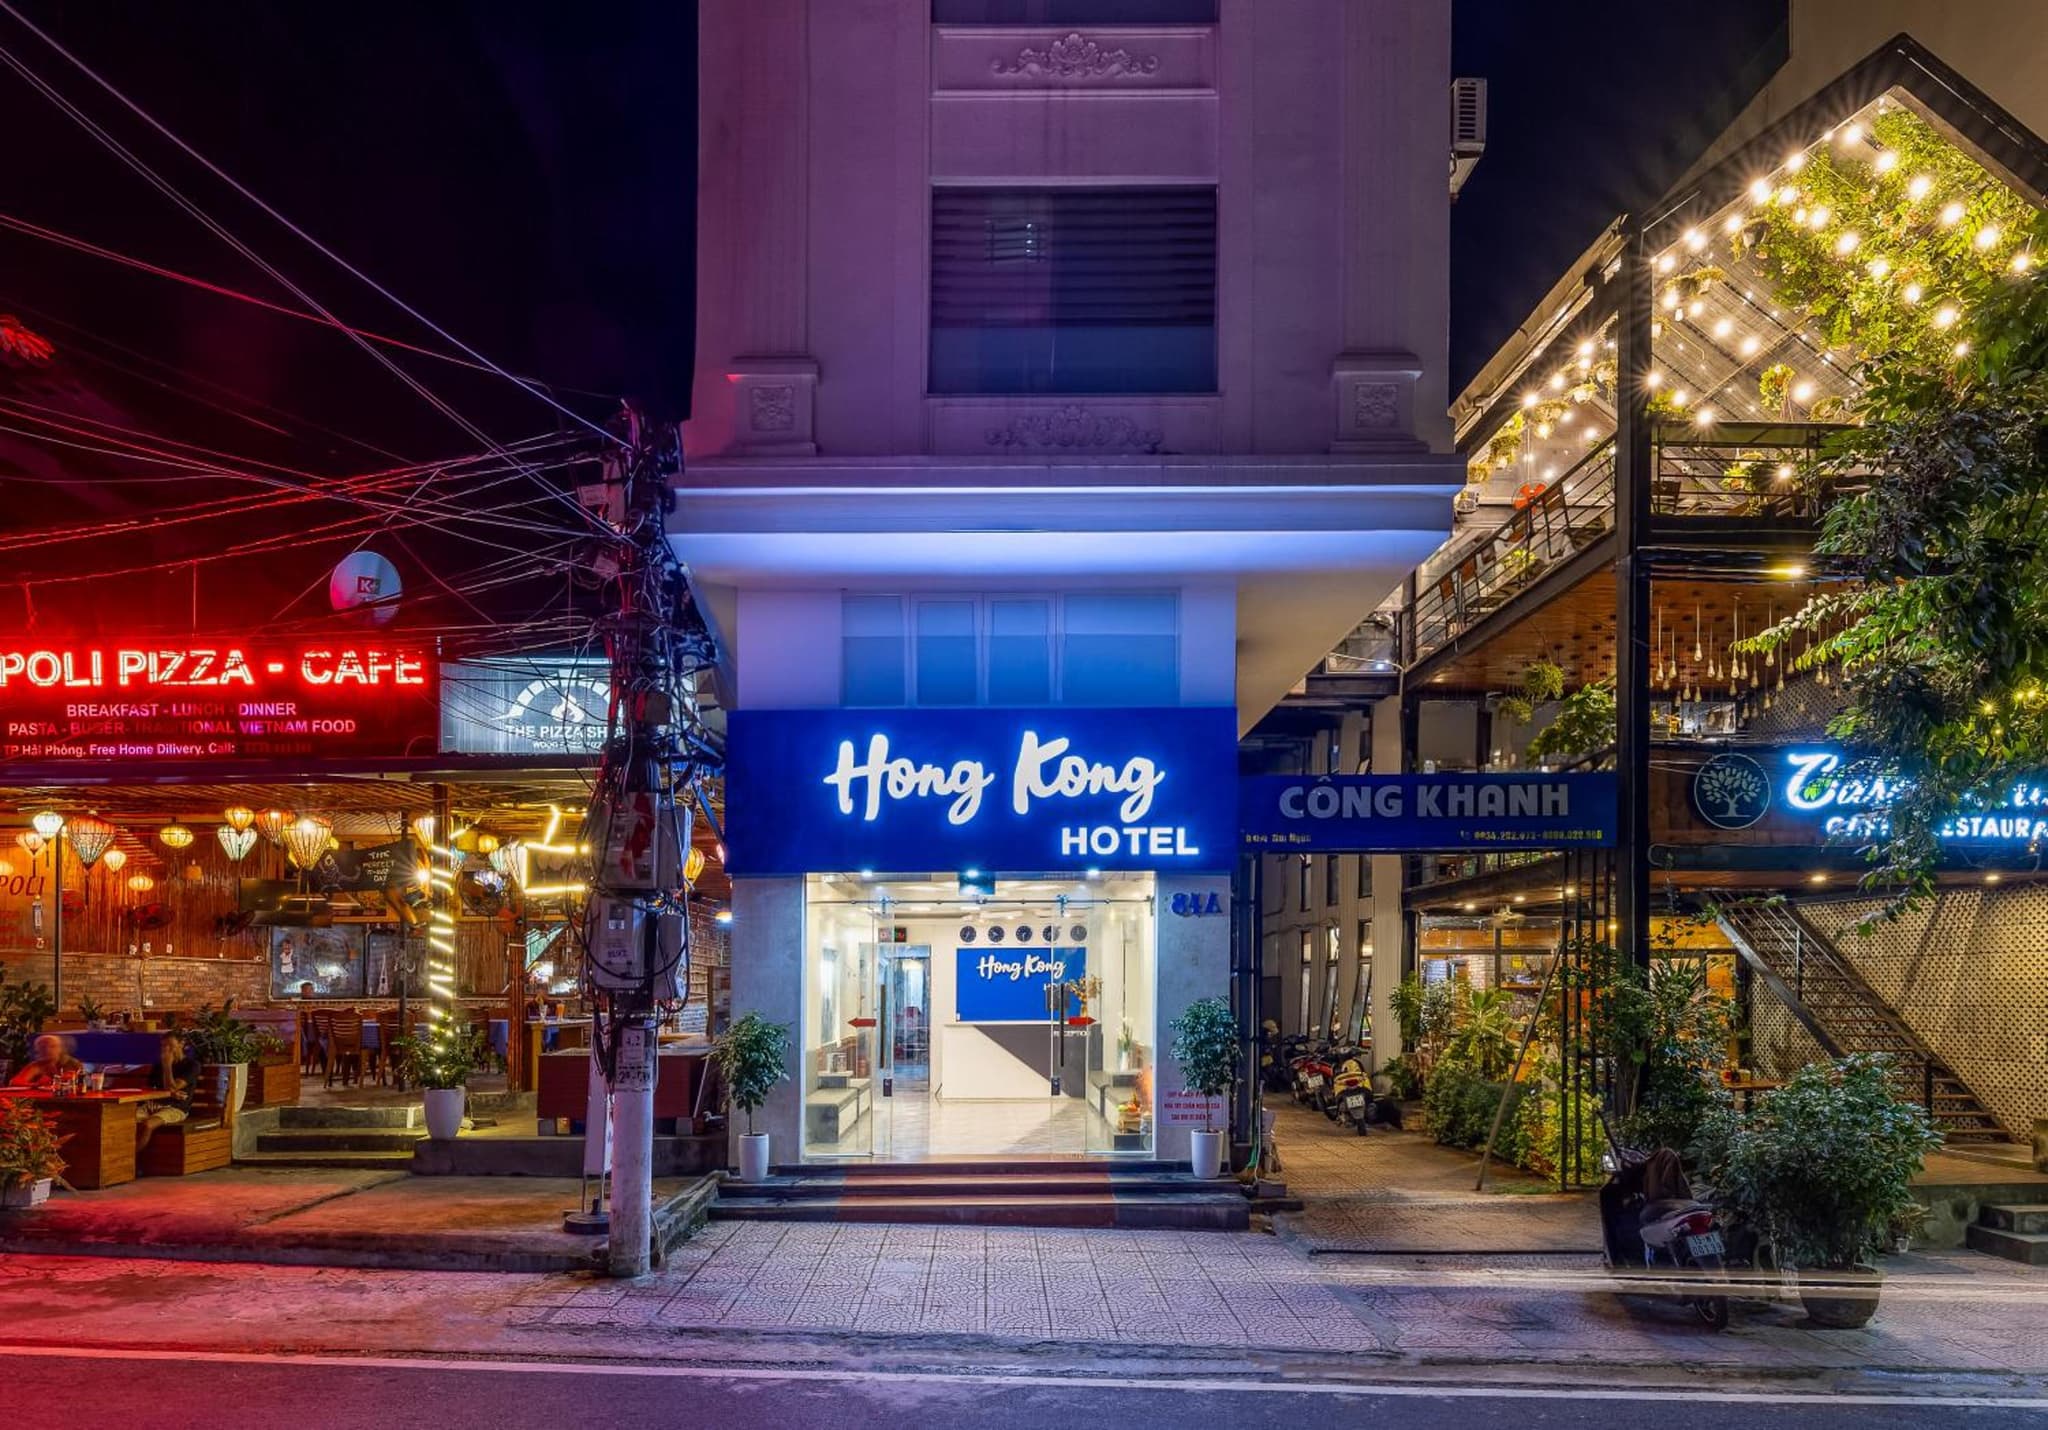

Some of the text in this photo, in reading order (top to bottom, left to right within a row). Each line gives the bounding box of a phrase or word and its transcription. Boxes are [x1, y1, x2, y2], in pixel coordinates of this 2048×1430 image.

[0, 652, 101, 687] POLI
[118, 650, 255, 686] PIZZA
[66, 703, 158, 718] BREAKFAST
[172, 703, 225, 717] LUNCH
[239, 702, 297, 717] DINNER
[8, 721, 57, 736] PASTA
[239, 719, 308, 734] VIETNAM
[312, 719, 356, 733] FOOD
[540, 725, 584, 738] PIZZA
[89, 742, 116, 755] Free
[119, 742, 153, 755] Home
[156, 741, 204, 756] Dilivery.
[208, 742, 236, 755] Call:
[823, 730, 1166, 825] Hong Kong
[1279, 776, 1569, 819] CÔNG KHANH
[1061, 827, 1199, 856] HOTEL
[976, 953, 1067, 981] Hong Kong
